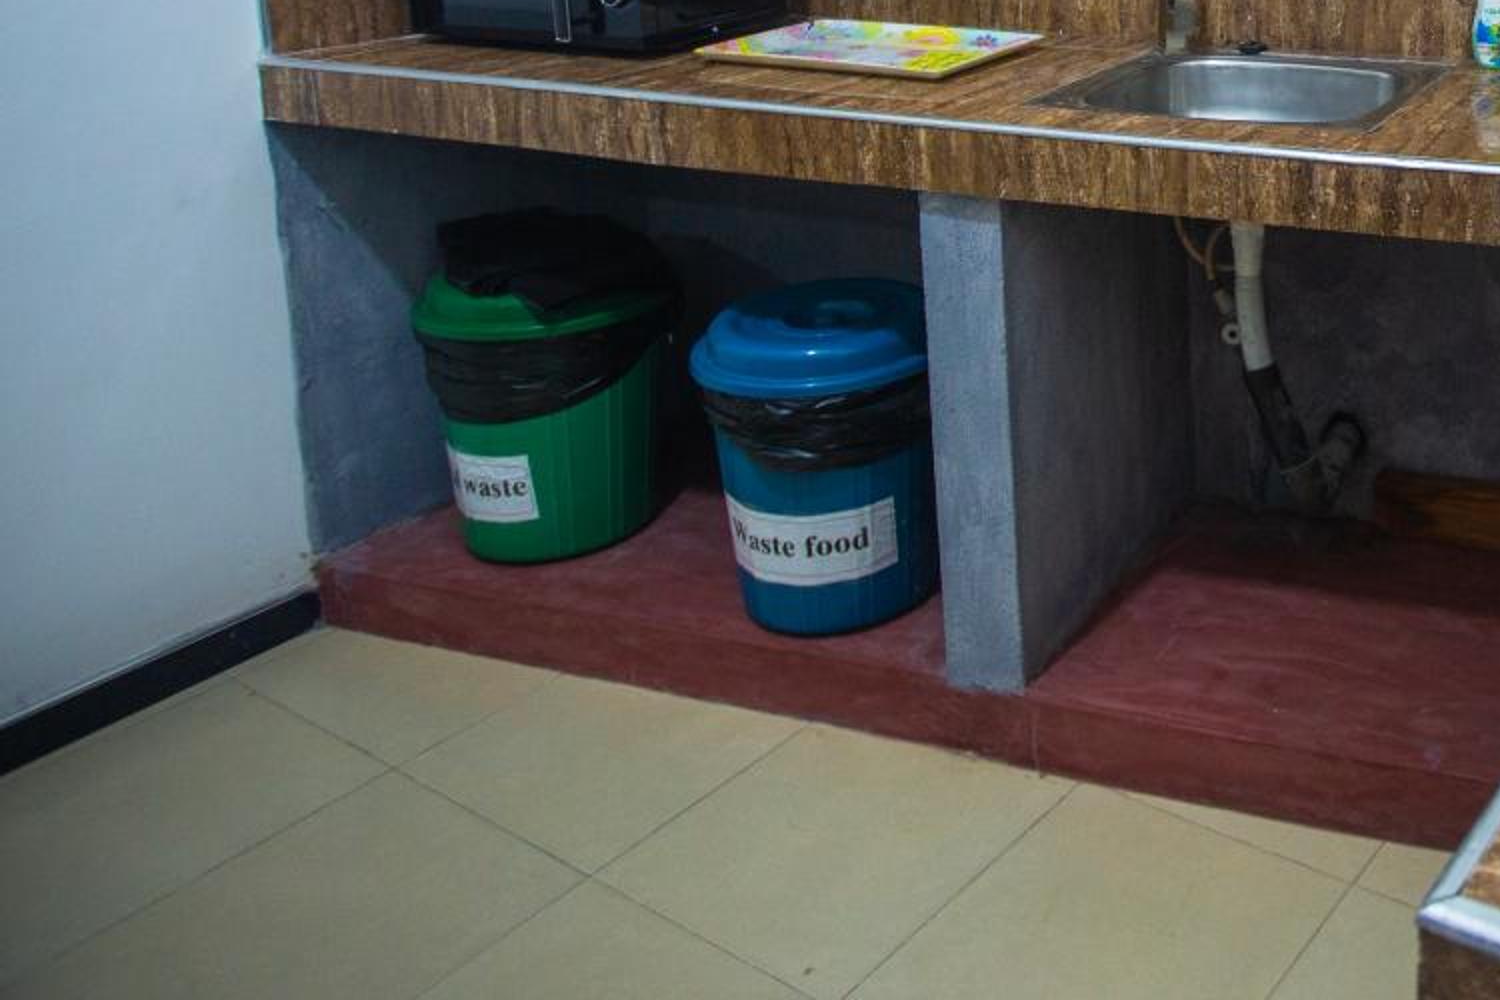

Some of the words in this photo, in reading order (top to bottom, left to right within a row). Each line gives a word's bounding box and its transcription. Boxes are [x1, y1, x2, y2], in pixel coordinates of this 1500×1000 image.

[463, 479, 527, 499] waste
[733, 516, 796, 558] Waste
[804, 525, 869, 559] food
